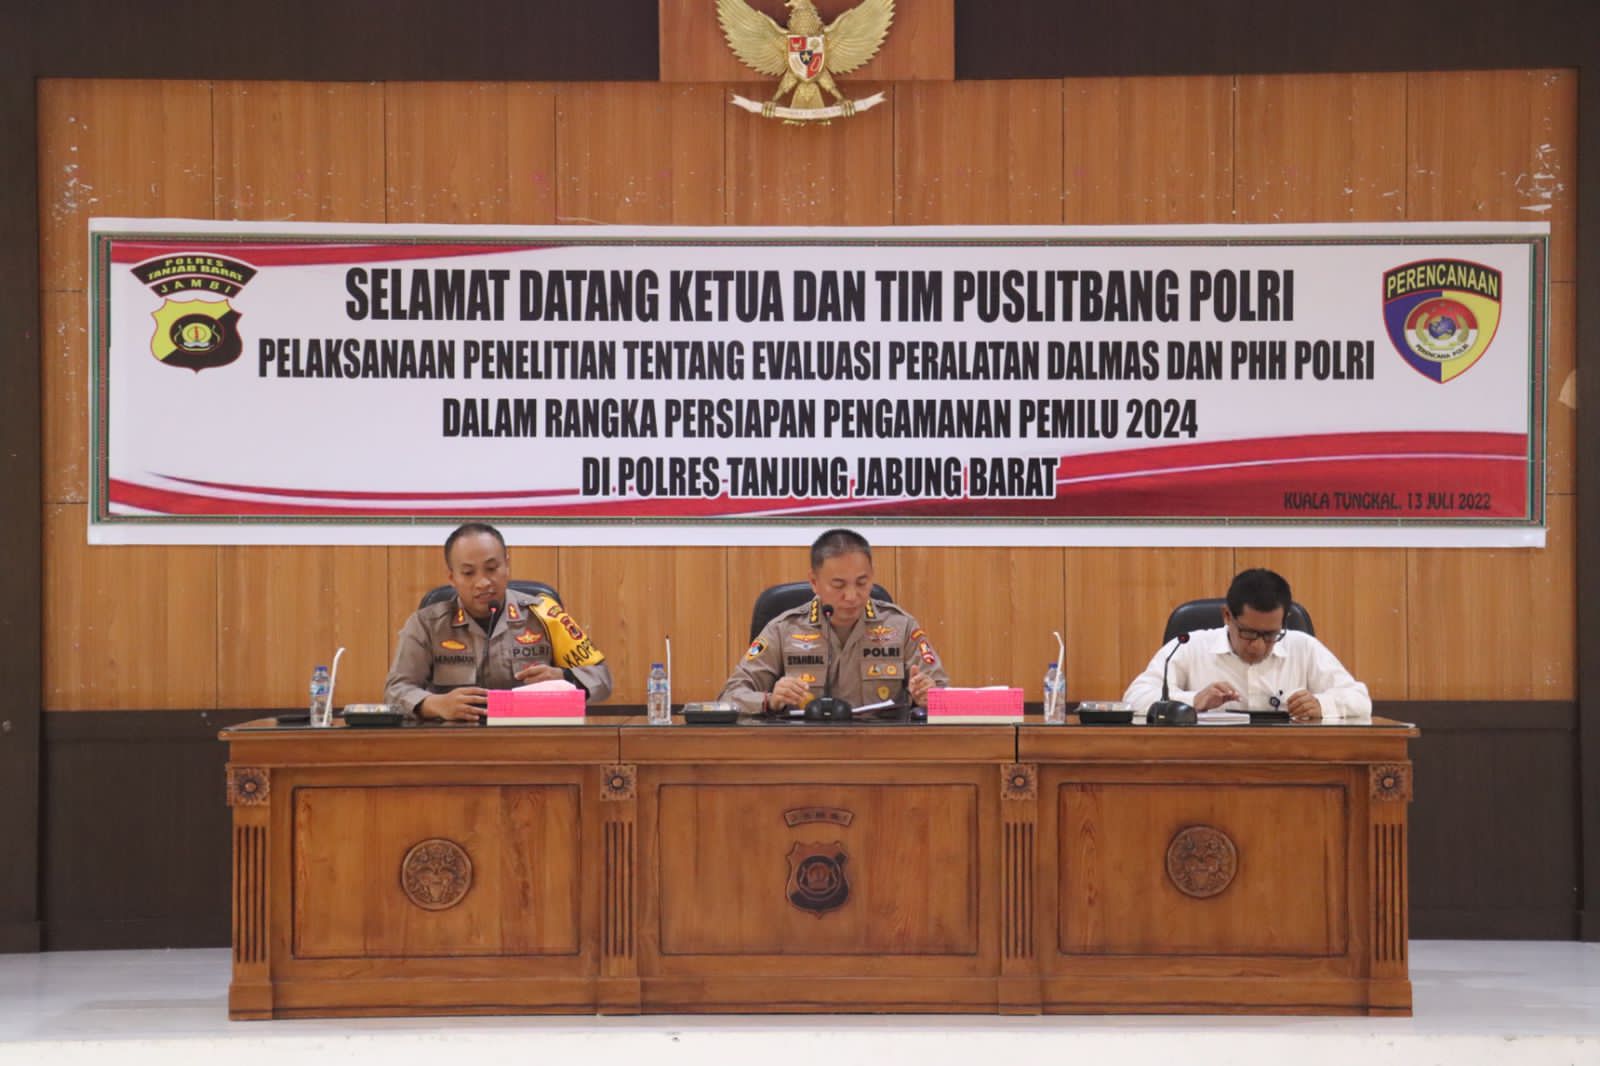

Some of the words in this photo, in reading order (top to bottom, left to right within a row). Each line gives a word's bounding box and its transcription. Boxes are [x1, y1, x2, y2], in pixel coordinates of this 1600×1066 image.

[165, 257, 223, 267] POLRES
[201, 265, 243, 281] BARAT
[161, 279, 231, 293] JAMBI
[1387, 264, 1498, 298] PERENCANAAN
[346, 268, 509, 320] SELAMAT
[520, 270, 658, 322] DATANG
[671, 271, 783, 322] KETUA
[794, 271, 865, 321] DAN
[876, 271, 942, 321] TIM
[954, 270, 1178, 322] PUSLITBANG
[1191, 269, 1293, 322] POLRI
[260, 339, 454, 378] PELAKSANAAN
[464, 341, 615, 379] PENELITIAN
[624, 341, 744, 380] TENTANG
[754, 341, 880, 380] EVALUASI
[890, 342, 1039, 379] PERALATAN
[1048, 341, 1159, 380] DALMAS
[1168, 341, 1222, 379] DAN
[1232, 341, 1286, 379] PHH
[1295, 341, 1374, 380] POLRI
[444, 399, 536, 437] DALAM
[546, 399, 657, 437] RANGKA
[666, 399, 815, 438] PERSIAPAN
[825, 399, 1010, 438] PENGAMANAN
[1020, 400, 1118, 438] PEMILU
[1127, 399, 1197, 438] 2024
[583, 458, 609, 495] DI
[619, 457, 719, 496] POLRES
[728, 458, 847, 496] TANJUNG
[856, 458, 960, 496] JABUNG
[971, 458, 1057, 496] BARAT
[1284, 492, 1330, 510] KUALA
[1408, 492, 1423, 510] 13
[1427, 492, 1454, 510] JULI
[1458, 492, 1491, 510] 2022
[863, 648, 899, 658] POLRI
